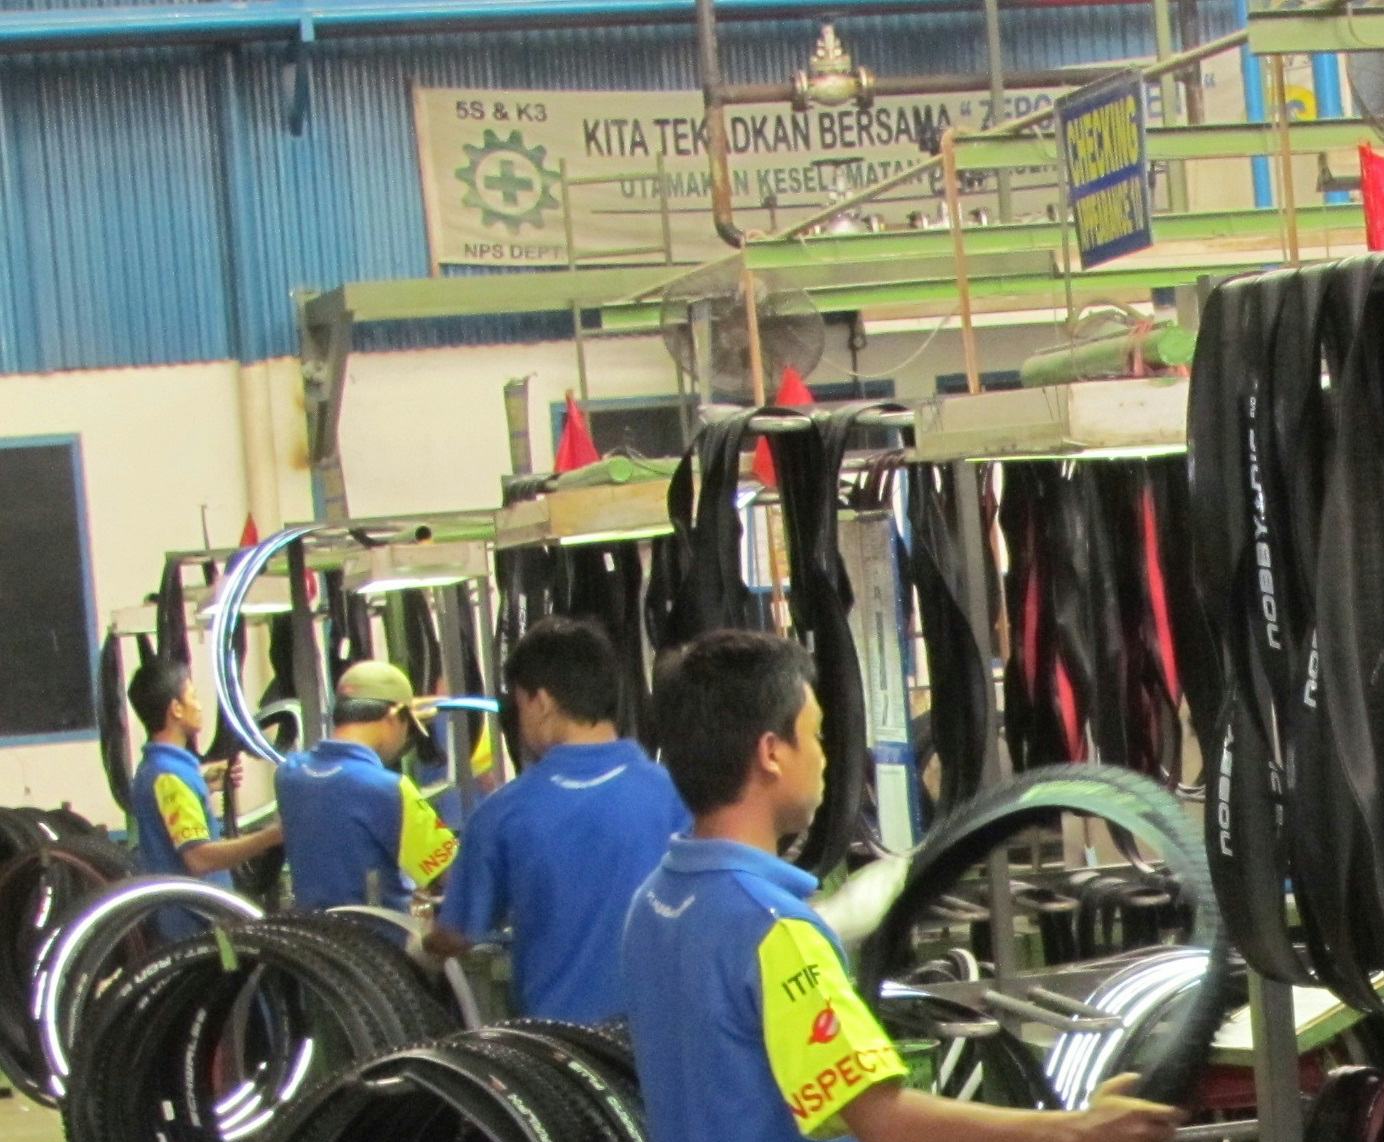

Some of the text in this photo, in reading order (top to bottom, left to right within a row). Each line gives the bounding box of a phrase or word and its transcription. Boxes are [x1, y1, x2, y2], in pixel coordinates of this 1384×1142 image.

[493, 102, 509, 122] &
[516, 103, 548, 123] K3
[583, 117, 649, 158] KITA
[653, 113, 811, 157] TEKDKAN
[1066, 95, 1139, 188] CHECKING
[464, 243, 504, 260] NPS
[1254, 515, 1282, 650] NOBBY
[419, 837, 460, 877] INSP
